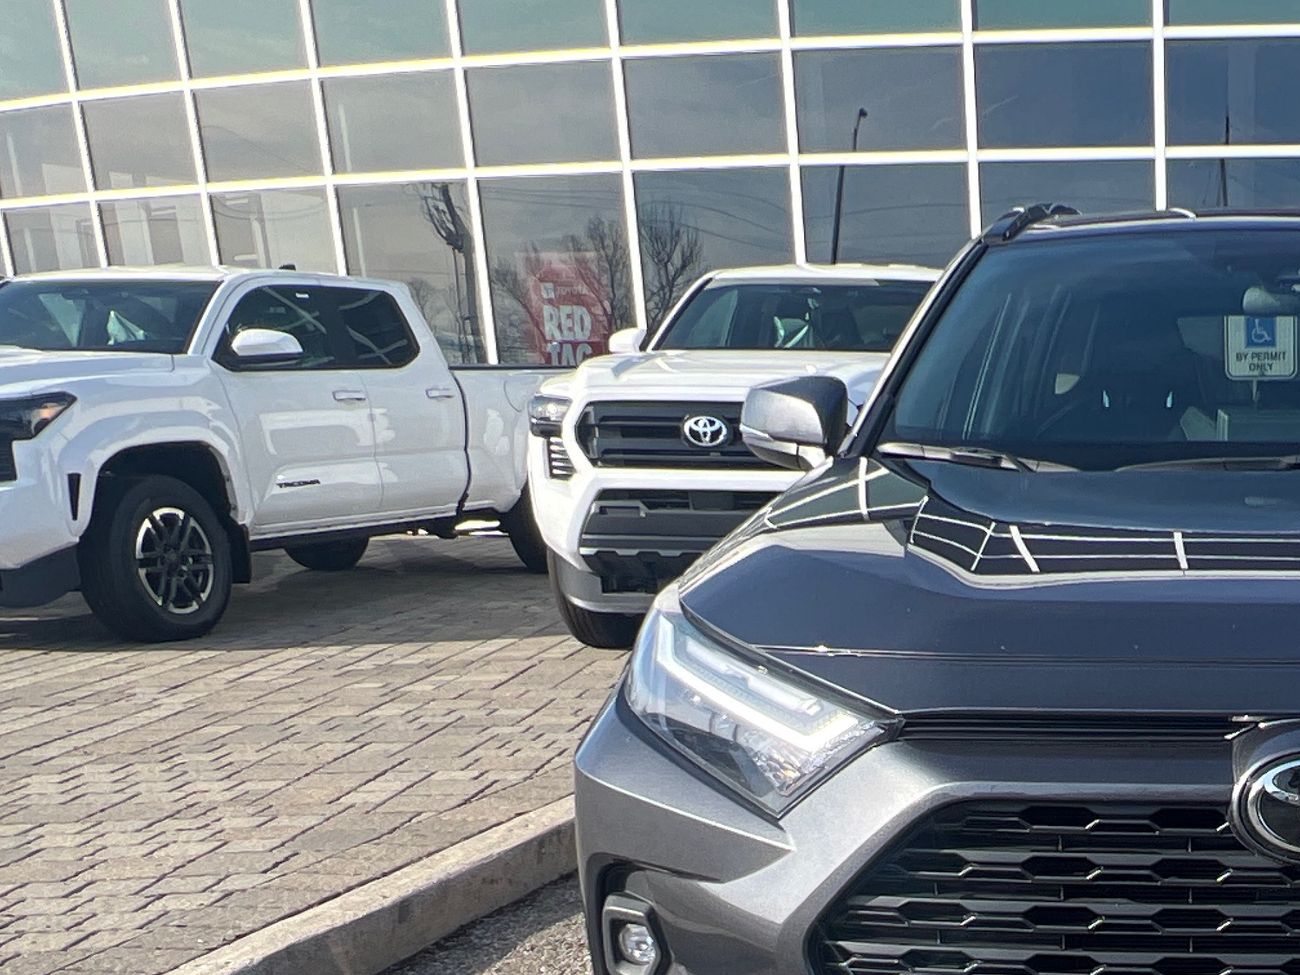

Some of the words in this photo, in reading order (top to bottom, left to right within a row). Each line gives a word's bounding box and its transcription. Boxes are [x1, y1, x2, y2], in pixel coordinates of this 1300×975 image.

[543, 304, 592, 340] RED
[1235, 352, 1248, 361] BY
[1251, 351, 1286, 361] PERMIT
[1248, 362, 1273, 371] ONLY
